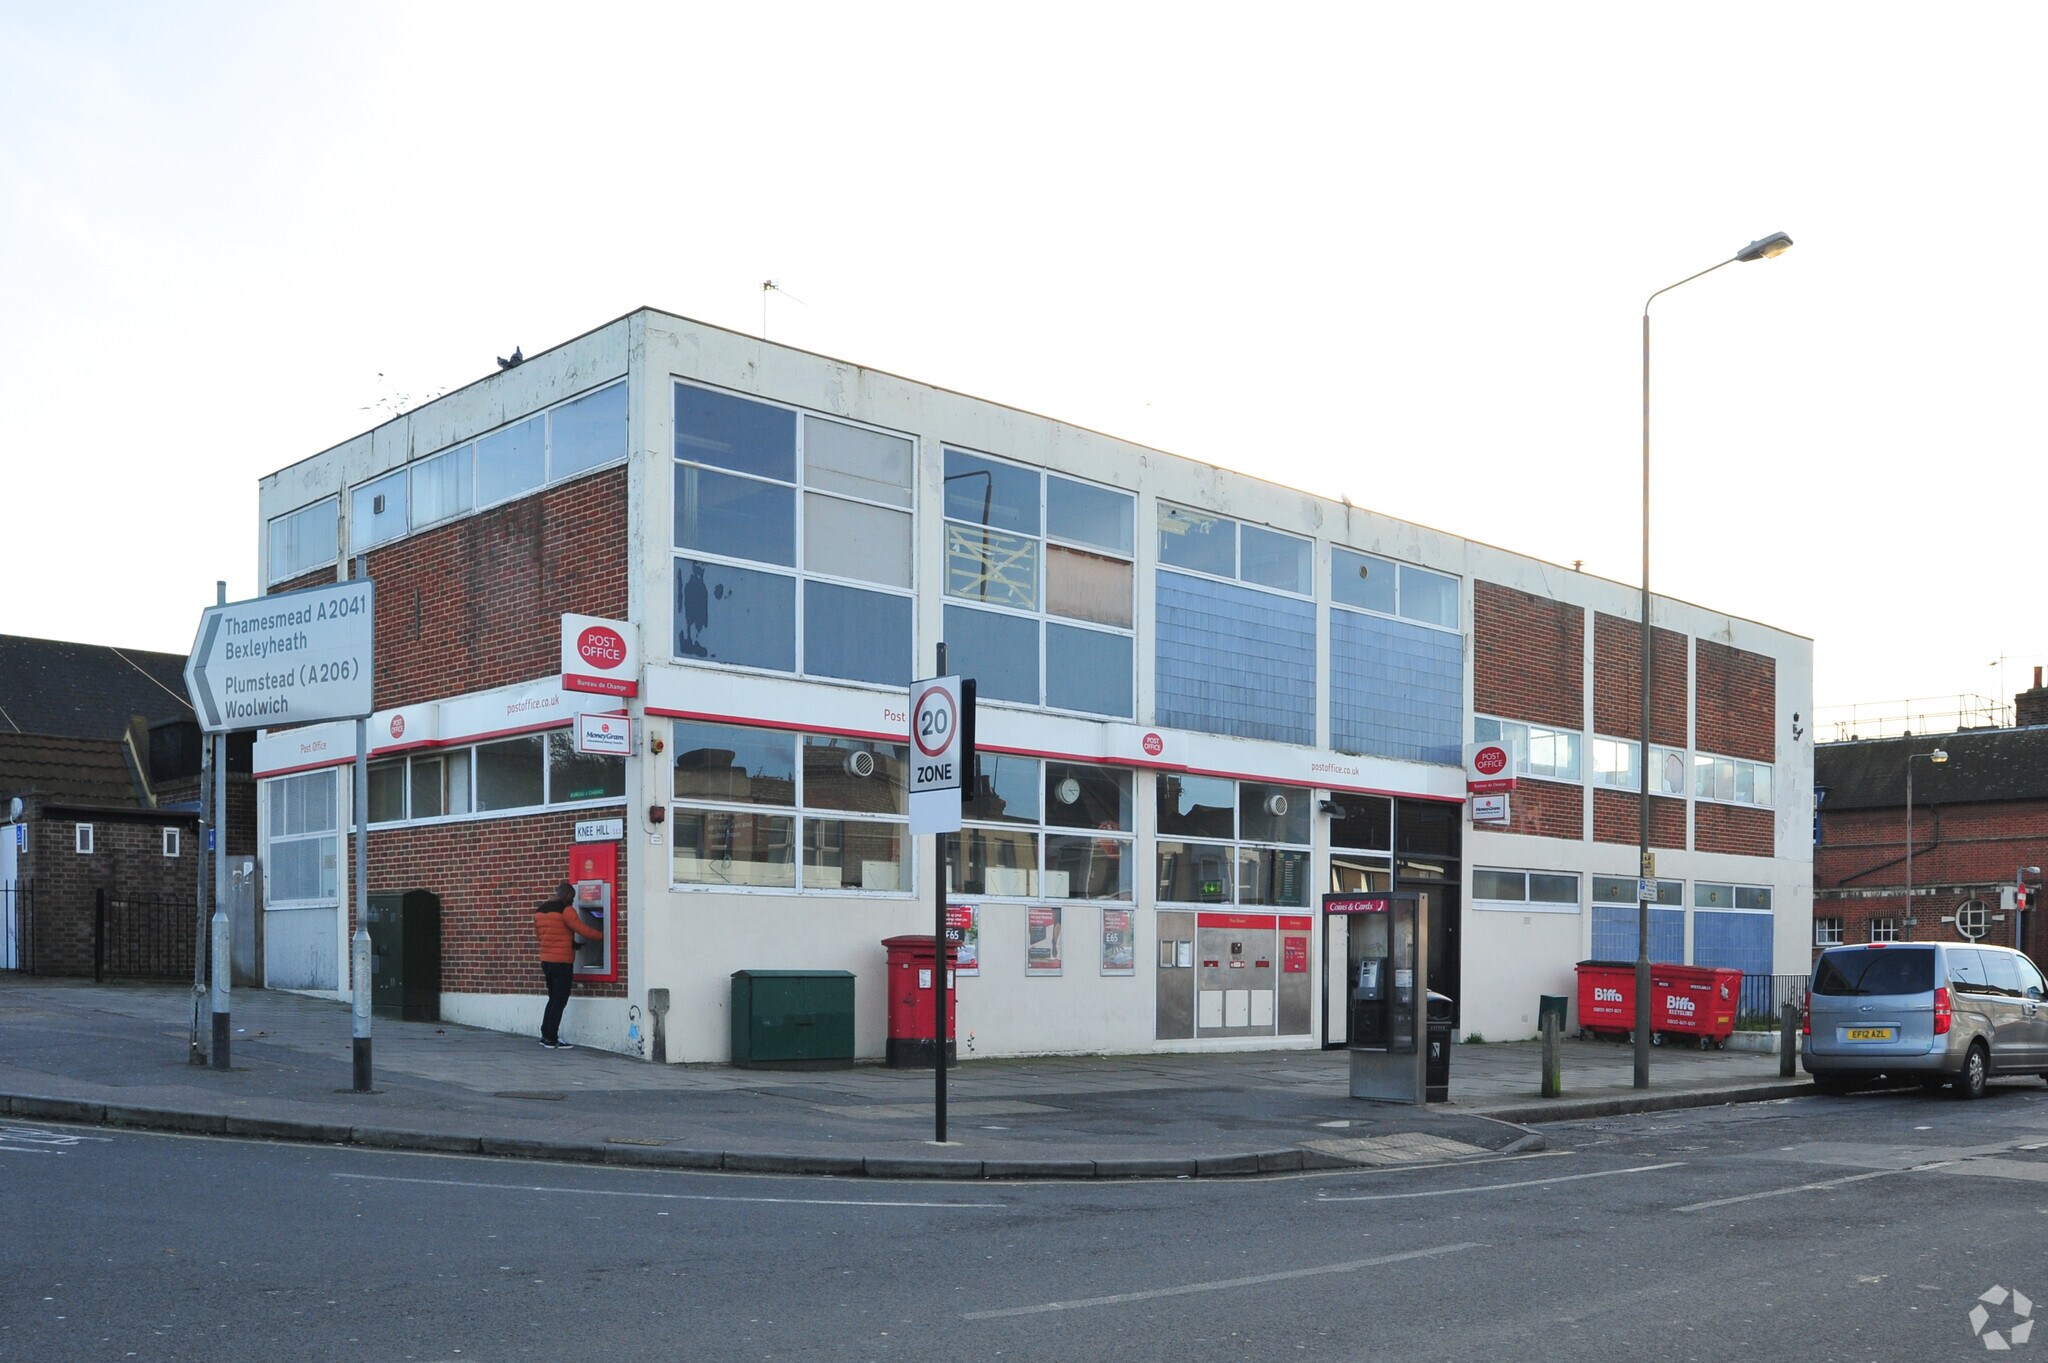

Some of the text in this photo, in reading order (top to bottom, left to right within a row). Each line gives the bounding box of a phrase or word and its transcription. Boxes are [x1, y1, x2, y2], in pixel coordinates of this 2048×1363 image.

[225, 595, 366, 636] Thamesmead A2041
[225, 631, 307, 660] Bexleyheath
[588, 634, 616, 648] POST
[581, 645, 620, 661] OFFICE
[225, 657, 359, 695] Plumstead (A206)
[576, 678, 598, 688] Bureau
[606, 681, 627, 692] Change
[225, 695, 289, 719] Woolwich
[506, 693, 560, 716] postoffice.co.uk
[392, 718, 403, 726] POST
[883, 708, 906, 723] Post
[921, 708, 948, 736] 20
[391, 725, 404, 734] OFFICE
[586, 731, 624, 741] MoneyGram
[300, 740, 327, 754] Post Office
[1144, 743, 1161, 751] OFFICE
[1482, 752, 1500, 760] POST
[1311, 762, 1360, 776] postoffice.co.uk
[1477, 760, 1503, 769] OFFICE
[917, 763, 952, 784] ZONE
[577, 825, 593, 837] KNEE
[595, 824, 610, 836] HILL
[1329, 901, 1373, 911] Coins & Cards
[1106, 933, 1118, 942] £65
[1594, 987, 1623, 1002] Biffa
[1666, 995, 1695, 1011] Biffa
[1669, 1009, 1693, 1017] RECYCLING
[1852, 1030, 1886, 1038] EF12 AZL
